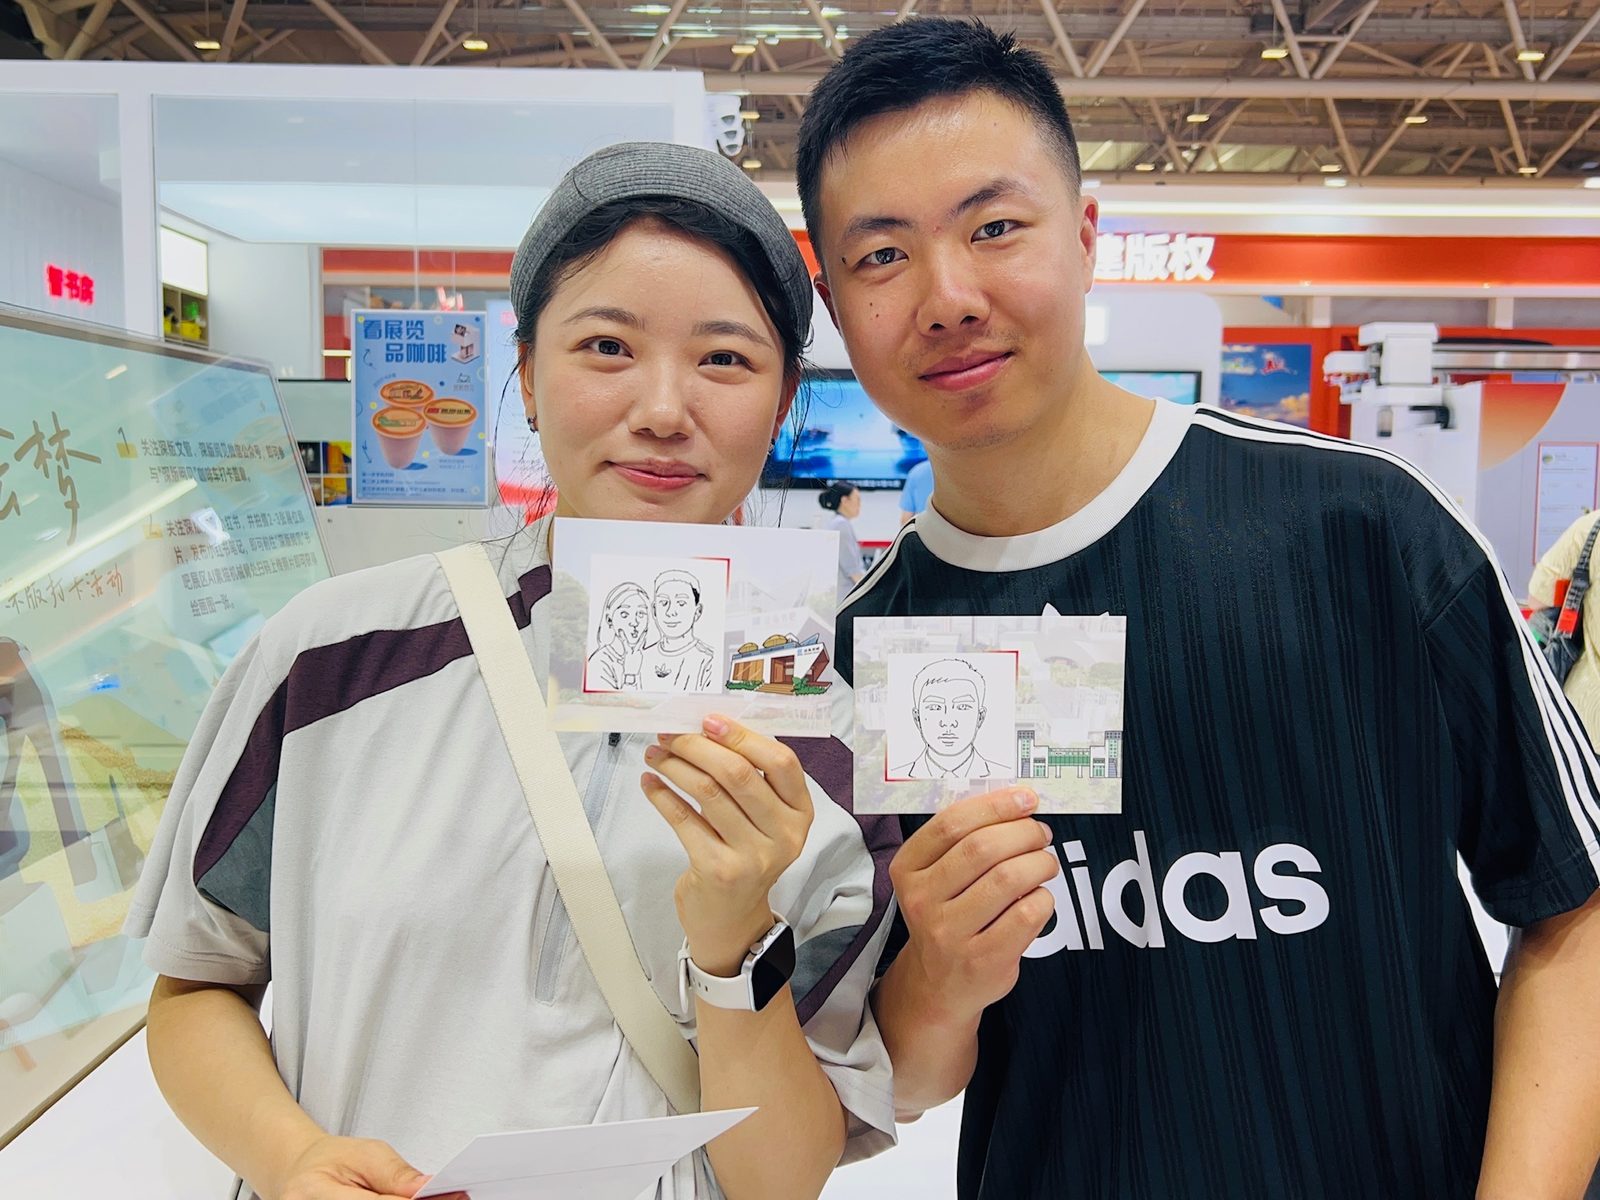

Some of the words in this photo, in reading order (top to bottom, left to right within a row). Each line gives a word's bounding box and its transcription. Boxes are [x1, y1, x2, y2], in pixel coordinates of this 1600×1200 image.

[363, 319, 425, 341] 看展览
[385, 342, 448, 364] 品咖啡
